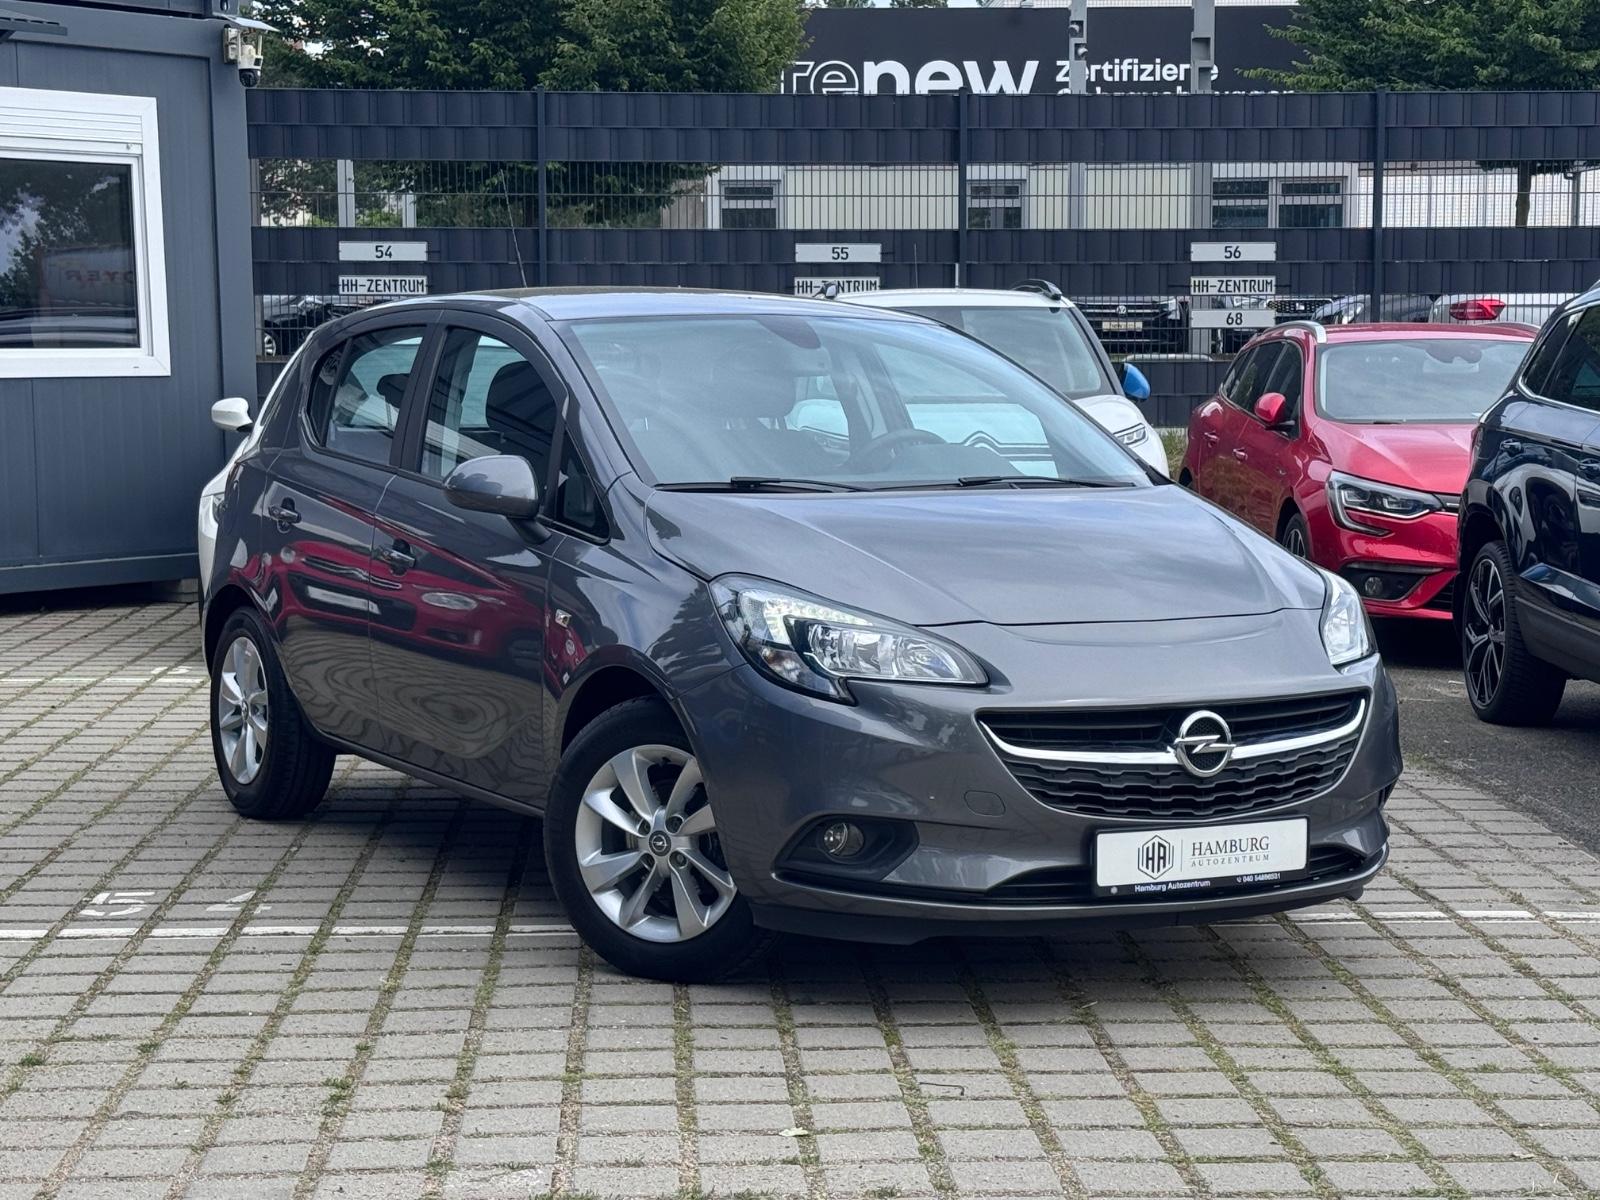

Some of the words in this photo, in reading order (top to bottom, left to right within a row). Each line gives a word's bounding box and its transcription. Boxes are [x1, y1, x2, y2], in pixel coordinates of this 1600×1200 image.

[375, 245, 392, 258] 54
[832, 246, 849, 260] 55
[1224, 246, 1241, 258] 56
[341, 279, 424, 292] HH-ZENTRUM
[1193, 280, 1273, 292] HH-ZENTRUM
[1226, 312, 1243, 325] 68
[1191, 836, 1270, 856] HAMBURG
[1191, 854, 1270, 867] AUTOZENTRUM
[1134, 882, 1166, 892] Hamburg
[1168, 880, 1210, 890] Autozentrum
